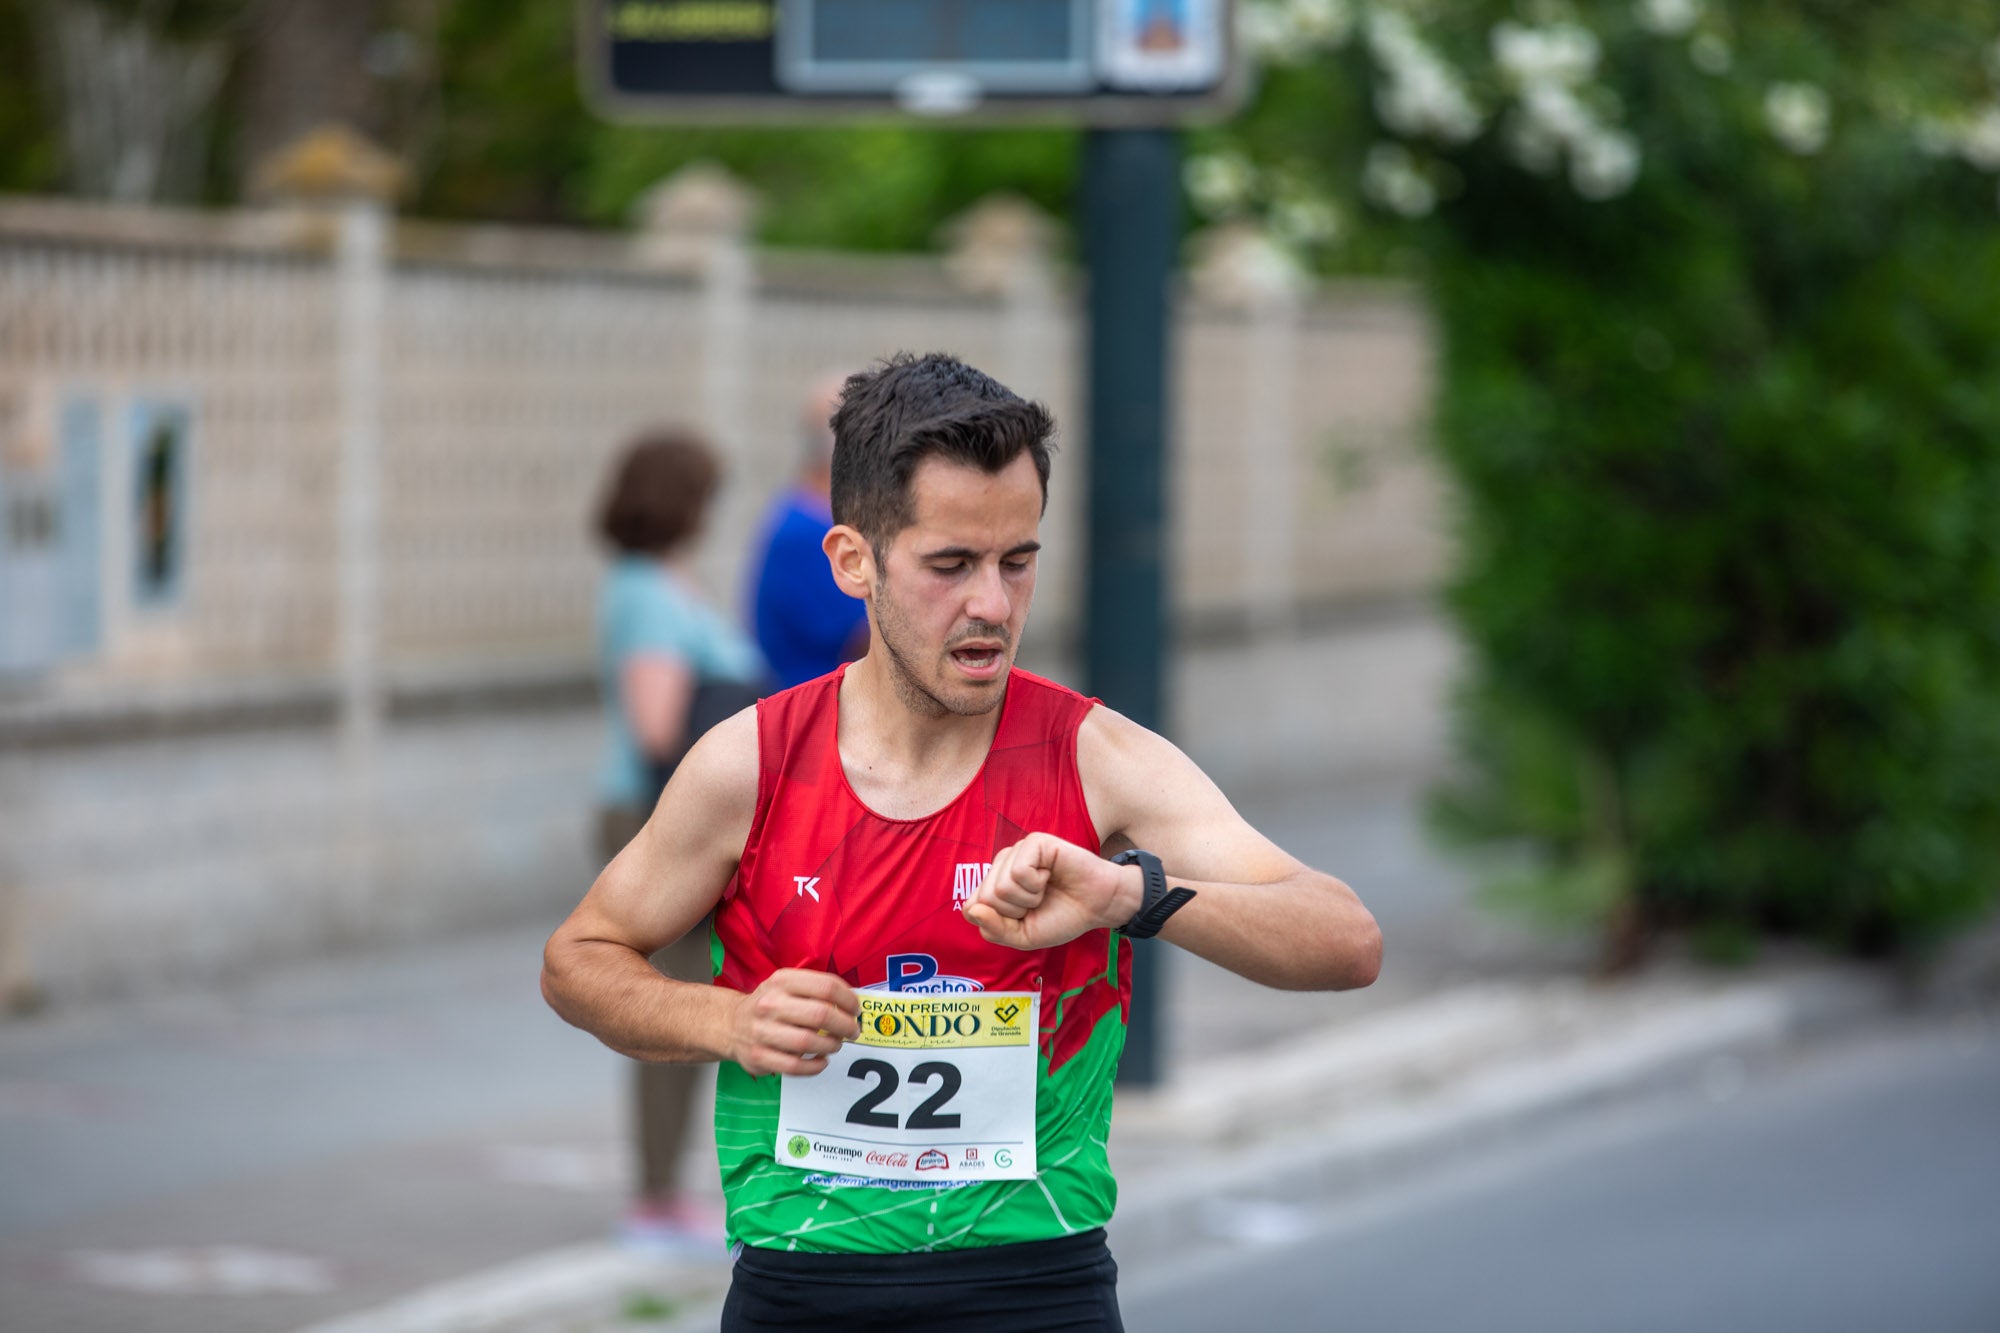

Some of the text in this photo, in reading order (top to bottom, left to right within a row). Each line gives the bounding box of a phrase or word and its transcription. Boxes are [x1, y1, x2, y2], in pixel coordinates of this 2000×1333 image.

[862, 999, 905, 1013] GRAN
[910, 1002, 969, 1013] PREMIO
[857, 1012, 981, 1037] FONDO
[845, 1058, 963, 1129] 22
[813, 1140, 863, 1158] Cruzcampo
